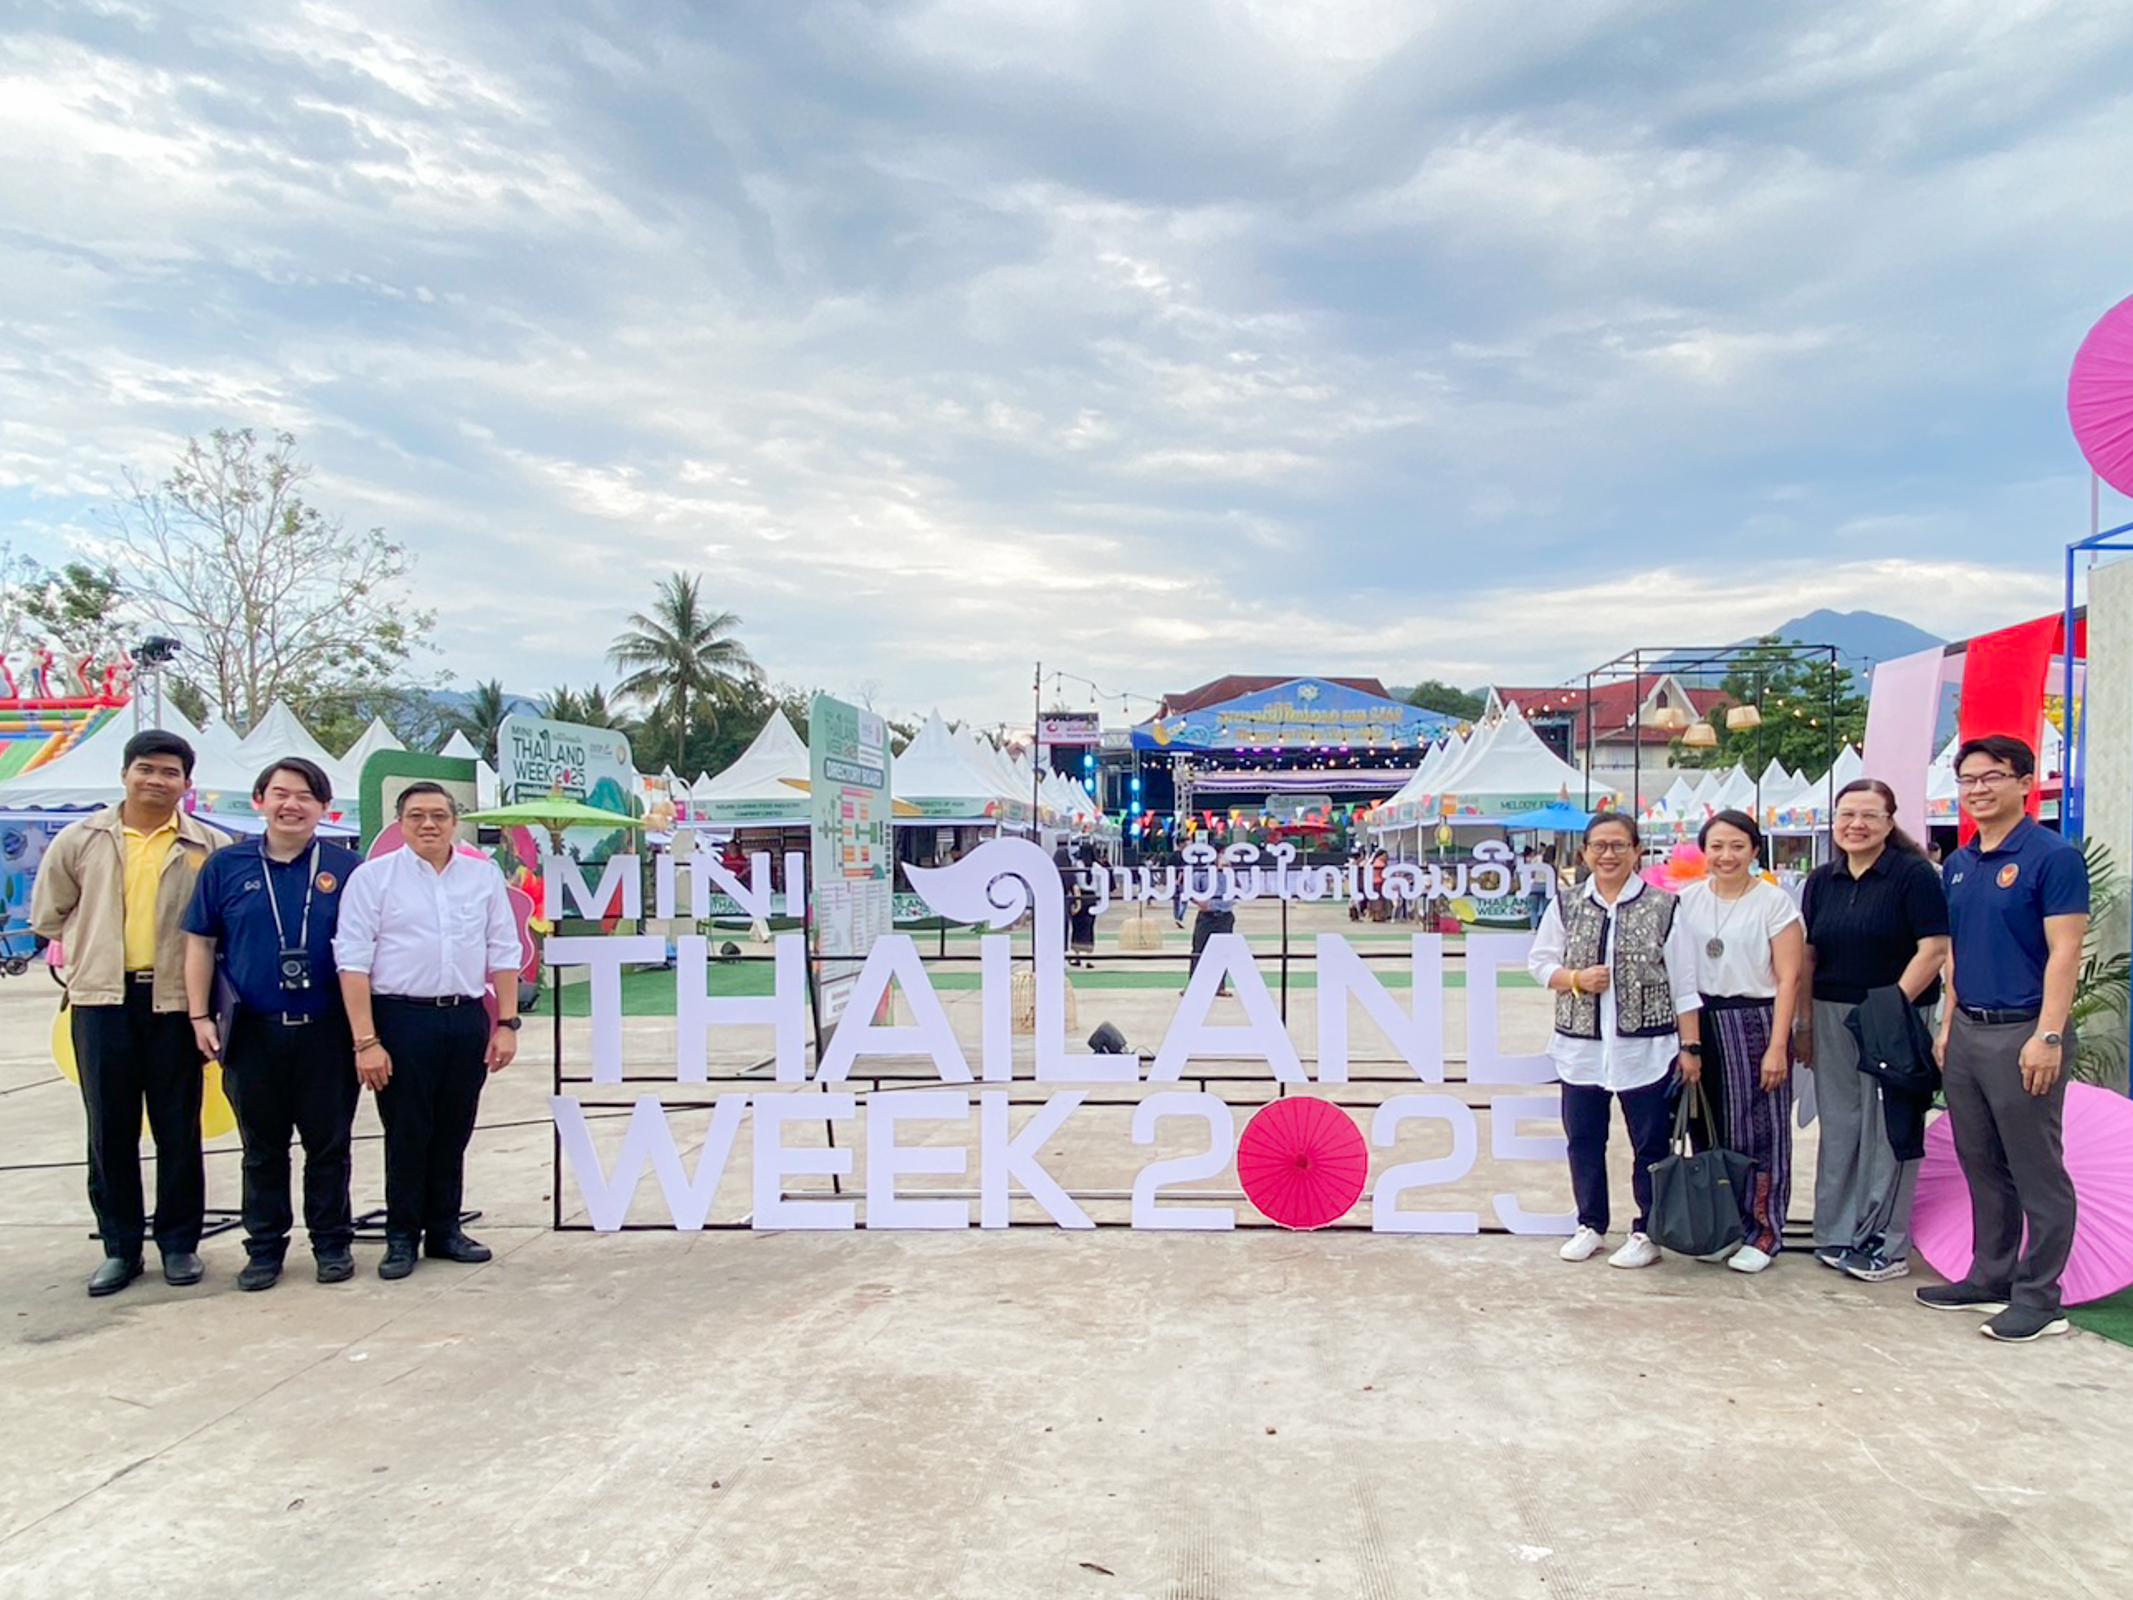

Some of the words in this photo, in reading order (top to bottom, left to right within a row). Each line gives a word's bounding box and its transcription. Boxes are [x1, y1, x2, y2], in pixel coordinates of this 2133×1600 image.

[511, 726, 532, 737] MINI
[513, 729, 585, 767] THAILAND
[513, 760, 553, 783] WEEK
[555, 766, 586, 787] 2025
[1500, 801, 1538, 810] MELODY
[544, 852, 805, 920] MINI
[1477, 907, 1506, 916] WEEK
[544, 838, 1560, 1083] THAILAND
[547, 1090, 1097, 1231] WEEK
[1131, 1091, 1579, 1236] 2025
